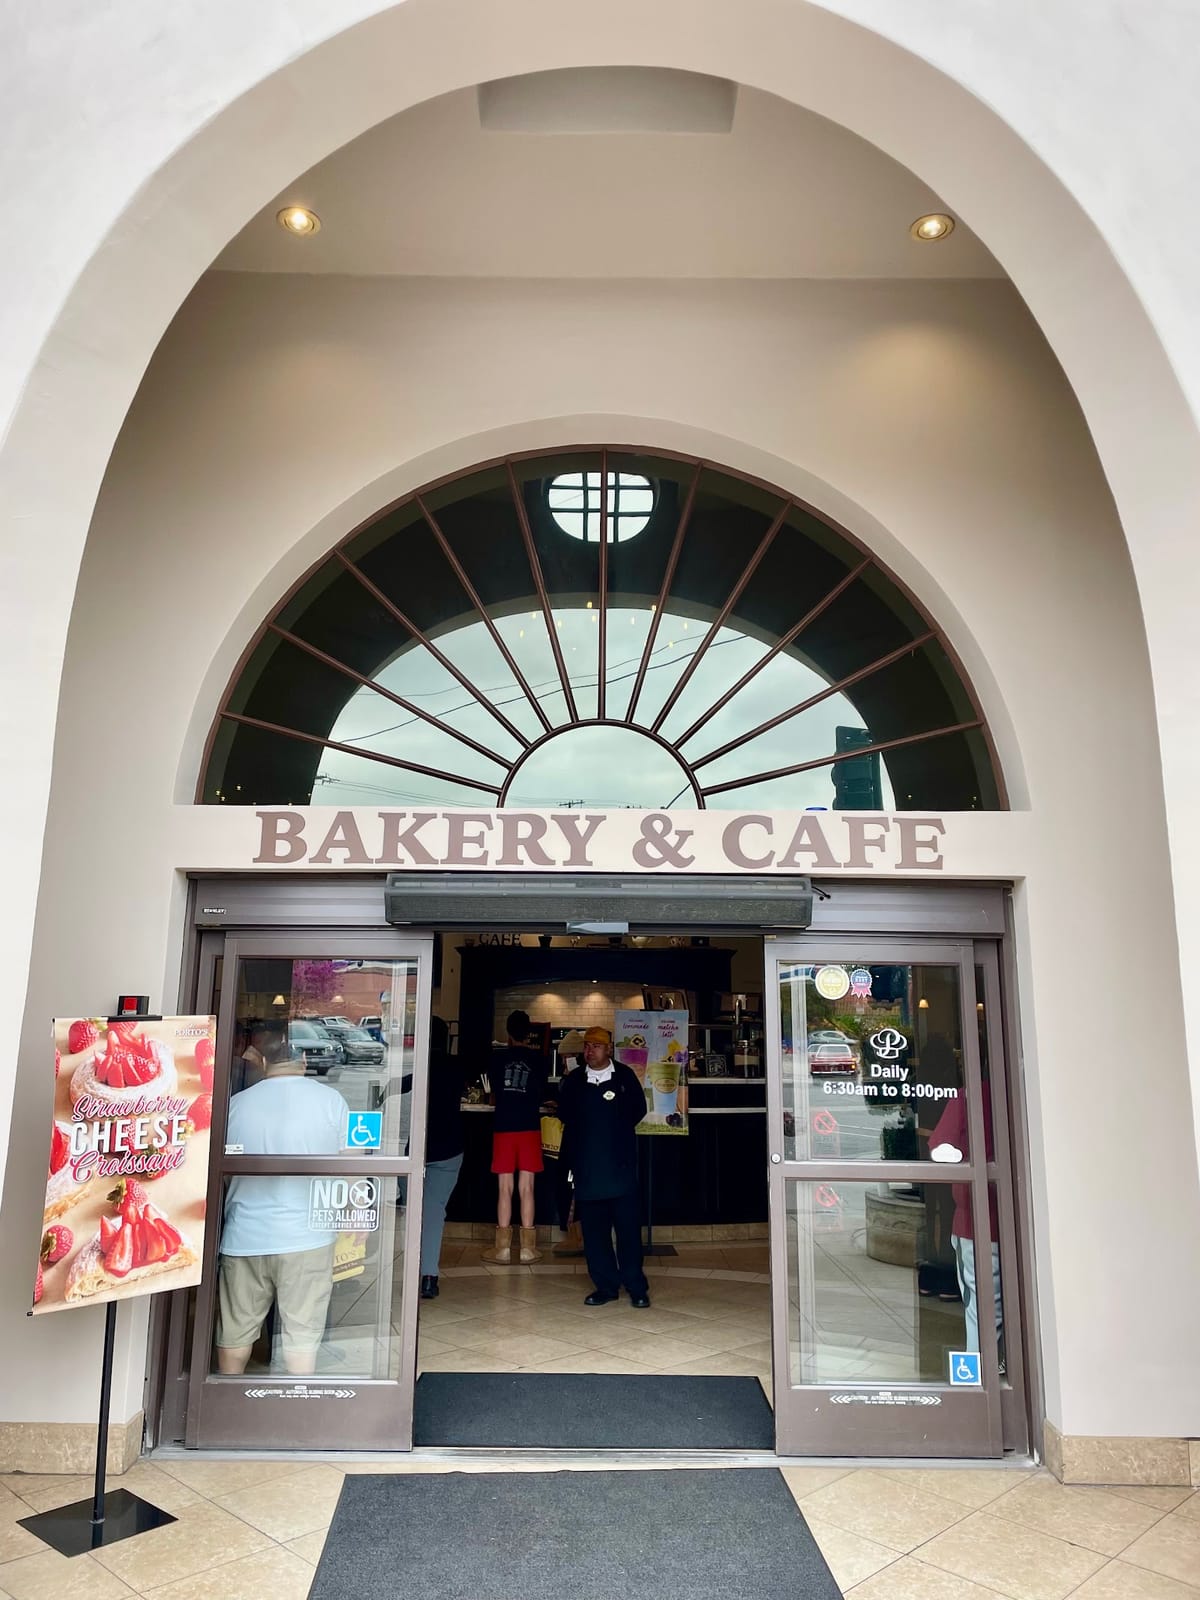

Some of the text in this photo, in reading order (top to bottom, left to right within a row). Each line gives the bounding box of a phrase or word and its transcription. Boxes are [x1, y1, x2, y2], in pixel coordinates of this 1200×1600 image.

[253, 811, 947, 870] BAKERY & CAFE
[871, 1064, 909, 1081] Daily
[823, 1081, 958, 1101] 6:30am to 8:00pm
[72, 1094, 187, 1121] Strawberry
[71, 1115, 187, 1156] CHEESE
[70, 1148, 185, 1182] Croissant
[313, 1180, 349, 1209] NO
[312, 1209, 376, 1222] PETS ALLOWED
